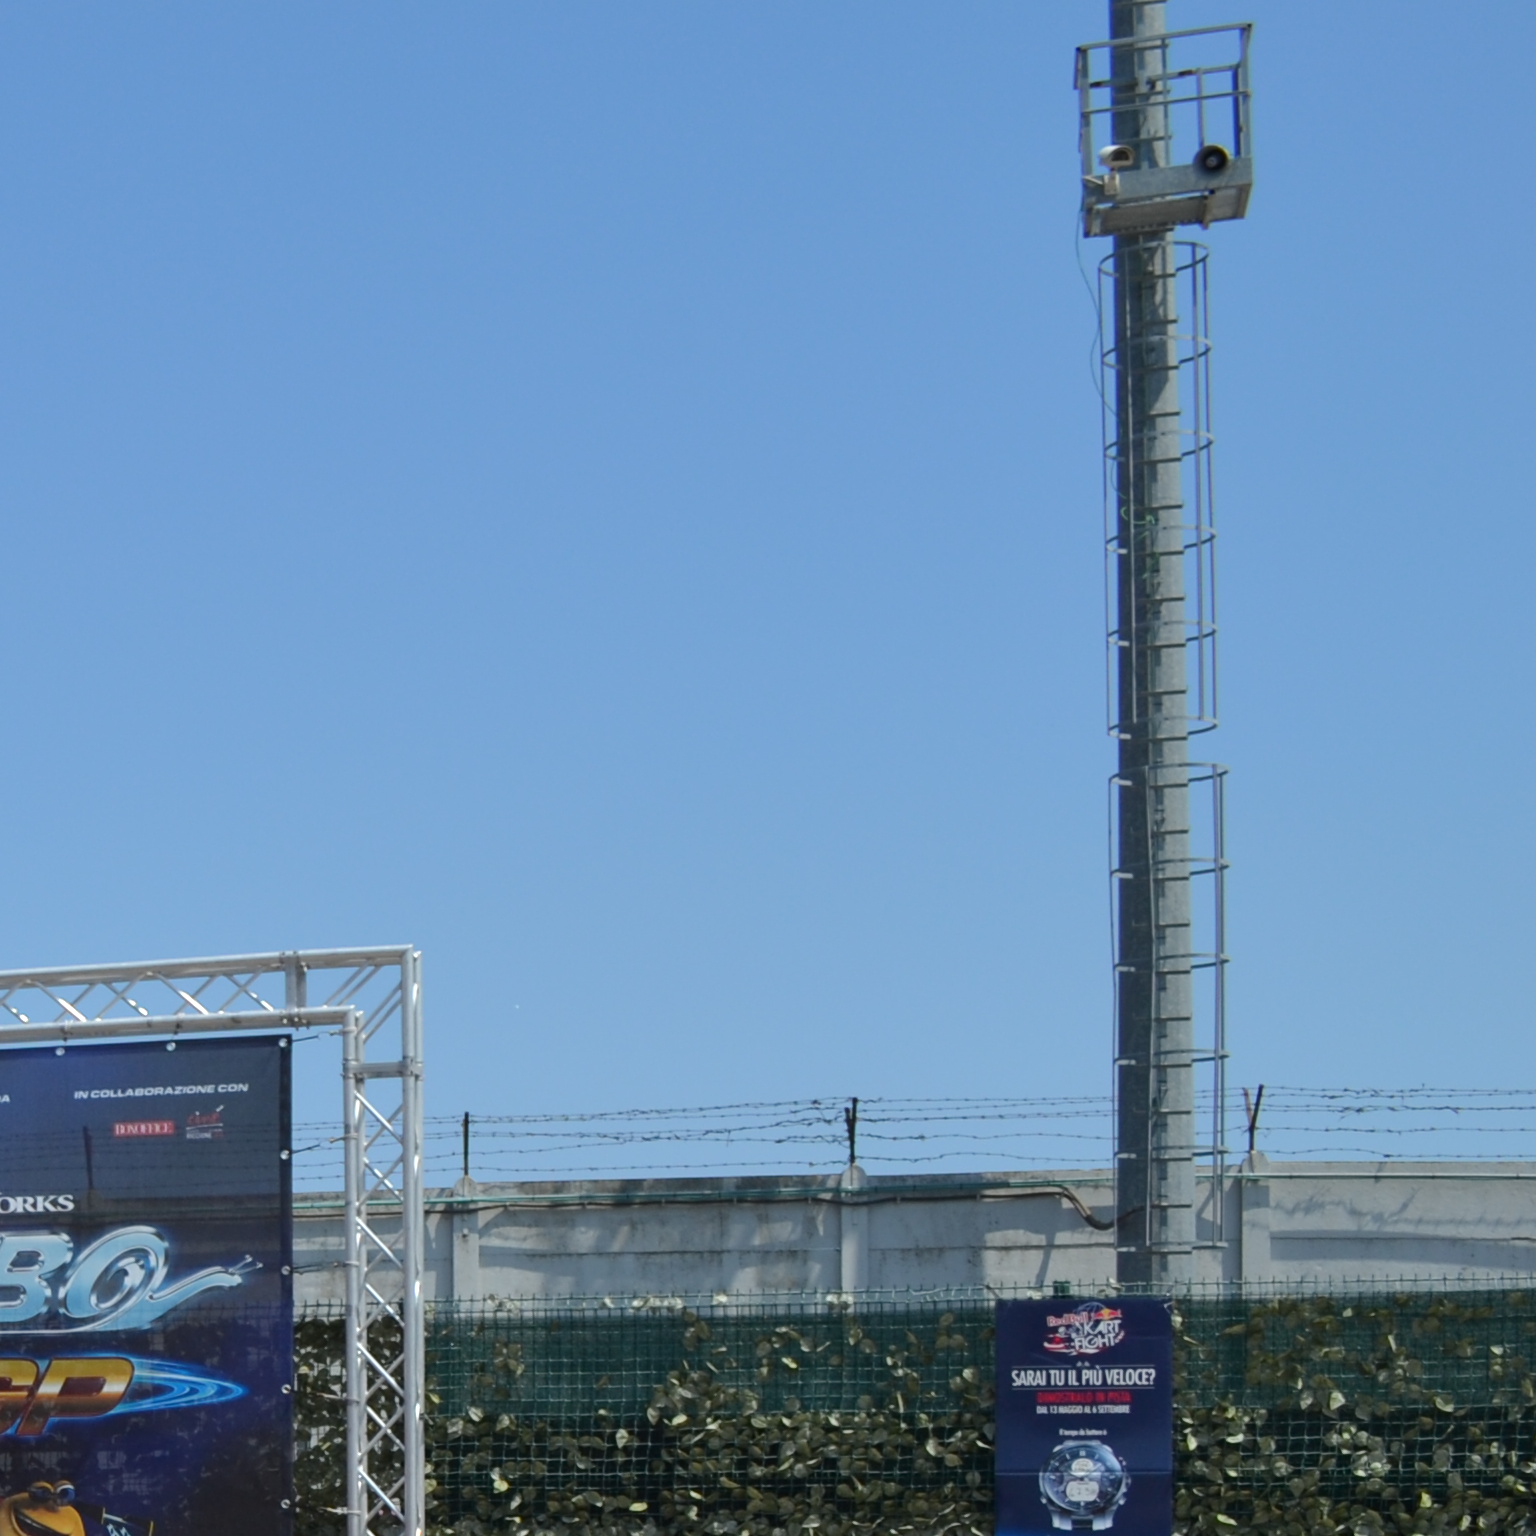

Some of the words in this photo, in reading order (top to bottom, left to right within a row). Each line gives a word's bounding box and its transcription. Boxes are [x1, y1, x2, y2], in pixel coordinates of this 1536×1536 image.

[74, 1091, 89, 1100] IN
[90, 1085, 215, 1099] COLLABORAZIONE
[217, 1083, 249, 1093] CON
[1081, 1320, 1122, 1336] KART
[1012, 1369, 1047, 1386] SARAI
[1049, 1369, 1065, 1386] TU
[1068, 1369, 1079, 1386] IL
[1081, 1365, 1102, 1386] PIÙ
[1106, 1369, 1156, 1386] VELOCE?
